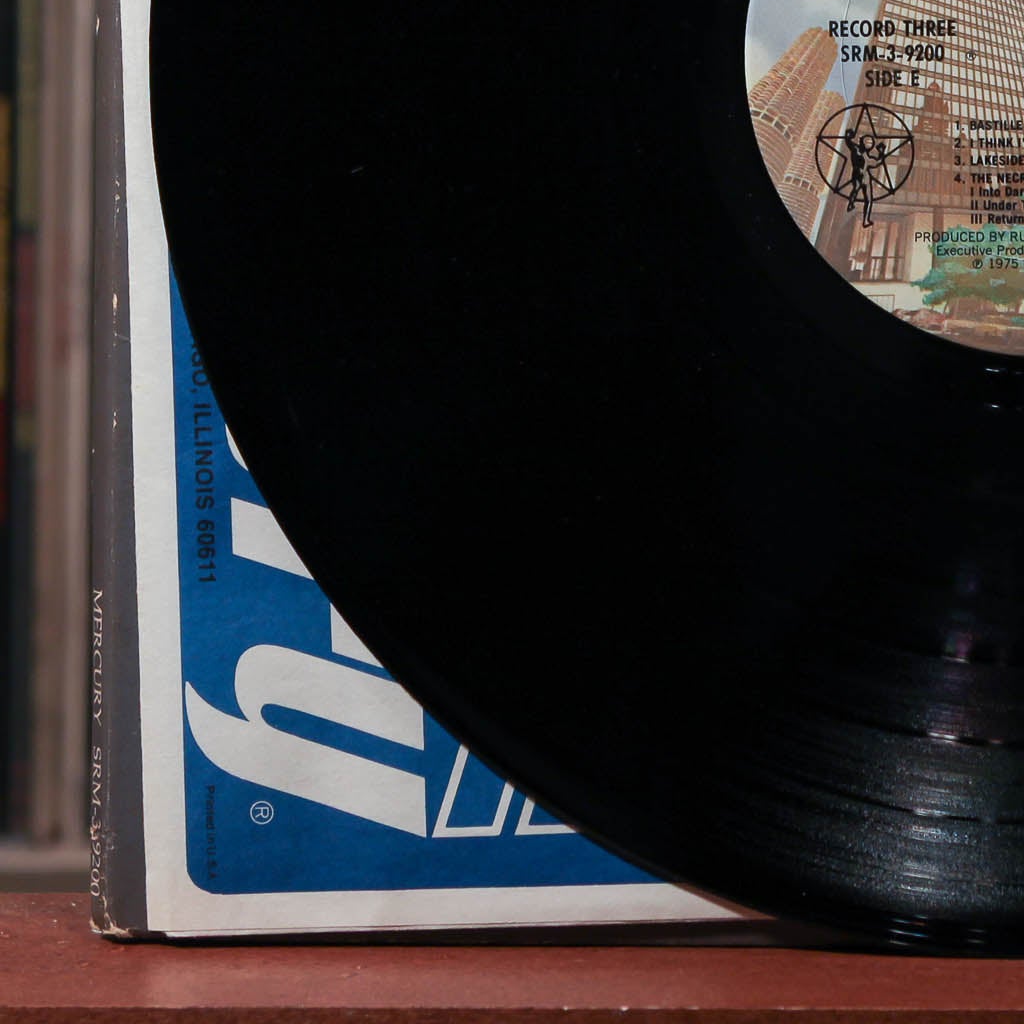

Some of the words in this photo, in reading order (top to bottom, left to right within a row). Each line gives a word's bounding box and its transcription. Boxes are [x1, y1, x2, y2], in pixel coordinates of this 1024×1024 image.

[828, 20, 896, 38] RECORD
[904, 19, 958, 37] THREE
[840, 44, 945, 63] SRM-3-9200
[865, 69, 902, 87] SIDE
[911, 69, 920, 87] E
[955, 120, 965, 130] 1.
[970, 120, 1023, 131] BASTILLE
[954, 139, 965, 149] 2.
[979, 137, 1013, 148] THINK
[954, 155, 965, 166] 3.
[970, 155, 1024, 166] LAKESIDE
[954, 173, 966, 184] 4.
[971, 173, 992, 183] THE
[979, 187, 1000, 197] Into
[970, 200, 978, 210] II
[983, 200, 1017, 210] Under
[970, 213, 982, 224] III
[988, 213, 1024, 224] Return
[914, 231, 985, 243] PRODUCED
[989, 231, 1006, 242] BY
[936, 245, 993, 256] Executive
[989, 258, 1019, 269] 1975
[193, 403, 215, 510] ILLINOIS
[197, 519, 217, 583] 60611
[92, 589, 104, 727] MERCURY
[90, 745, 103, 897] SRM-39200
